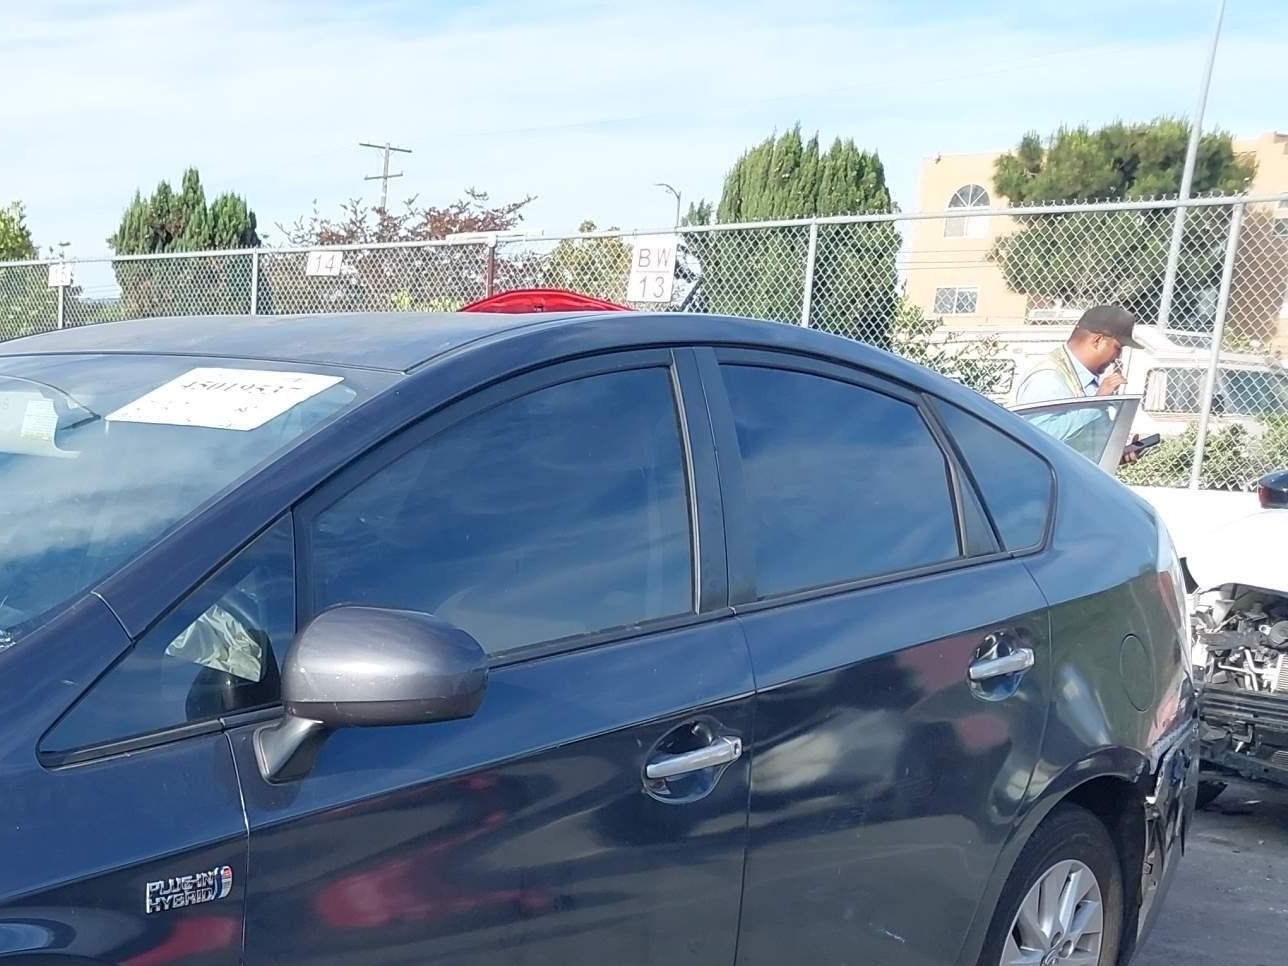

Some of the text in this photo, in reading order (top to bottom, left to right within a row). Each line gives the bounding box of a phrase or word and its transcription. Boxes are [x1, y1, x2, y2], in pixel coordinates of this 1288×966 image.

[316, 254, 336, 273] 14
[638, 247, 671, 268] BW
[639, 275, 665, 298] 13
[146, 886, 217, 914] HYBRID
